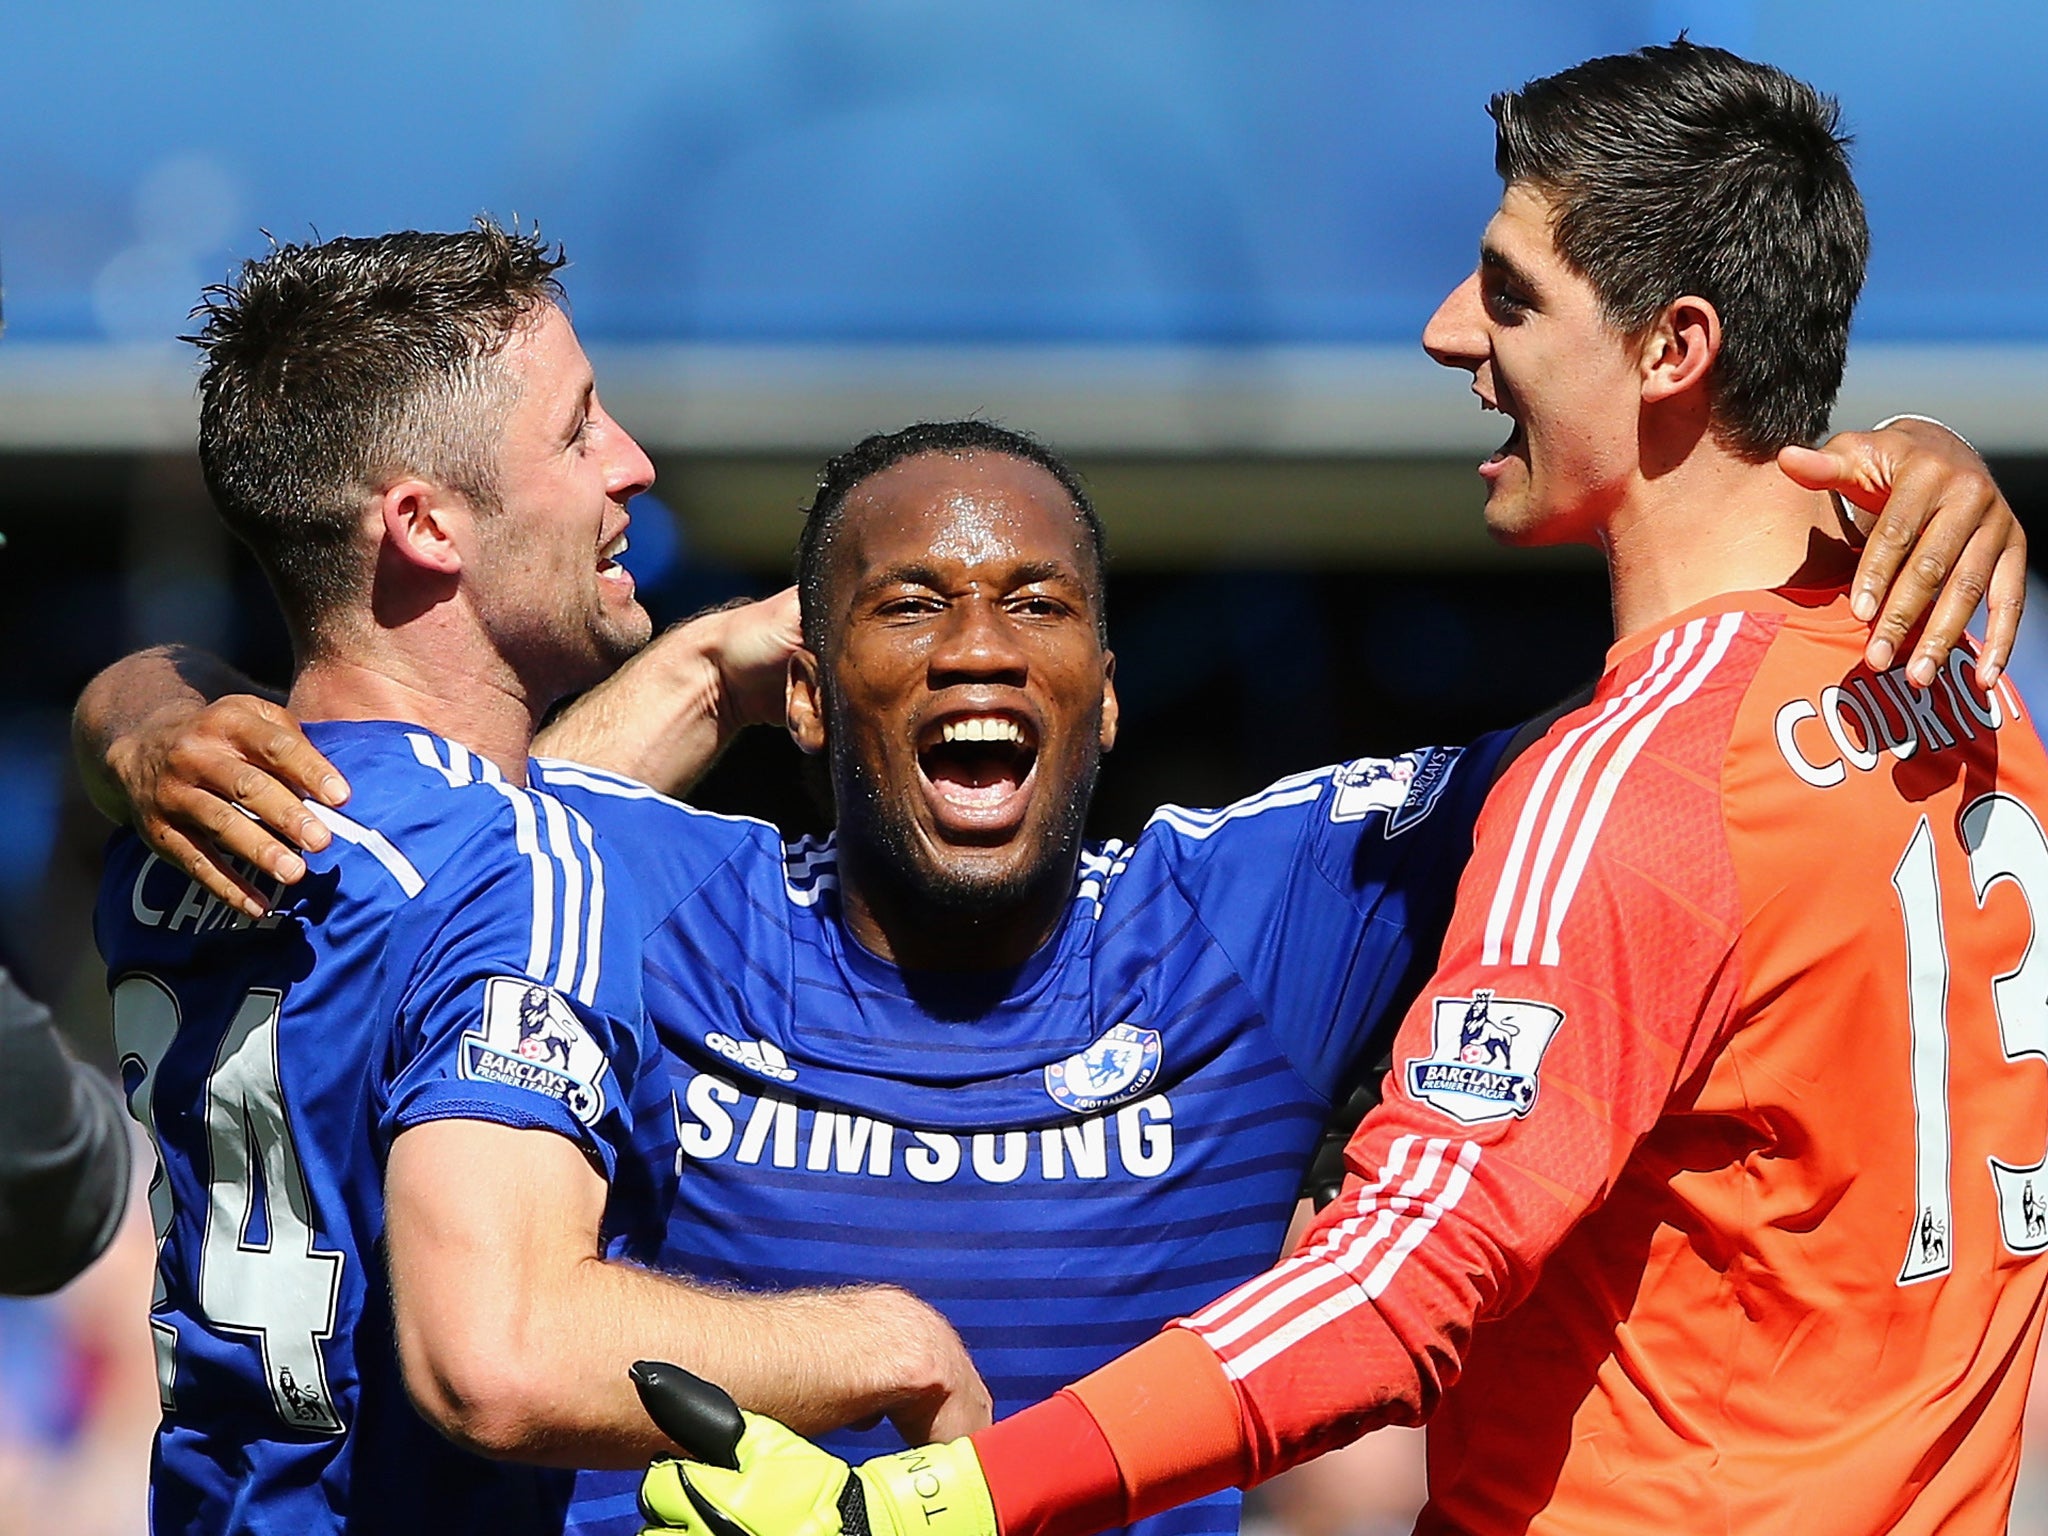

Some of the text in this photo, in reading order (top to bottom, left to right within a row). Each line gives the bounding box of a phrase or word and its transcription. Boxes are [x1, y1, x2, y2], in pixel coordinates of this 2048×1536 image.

[1893, 785, 2048, 1286] 13
[475, 1065, 522, 1088] PREMIER
[479, 1051, 570, 1093] BARCLAYS
[704, 1031, 798, 1082] adidas
[1074, 1068, 1152, 1109] FOOTBALL CLUB
[1421, 1080, 1508, 1100] PREMIER LEAGUE
[1425, 1065, 1513, 1091] BARCLAYS
[680, 1073, 1174, 1183] SAMSUNG
